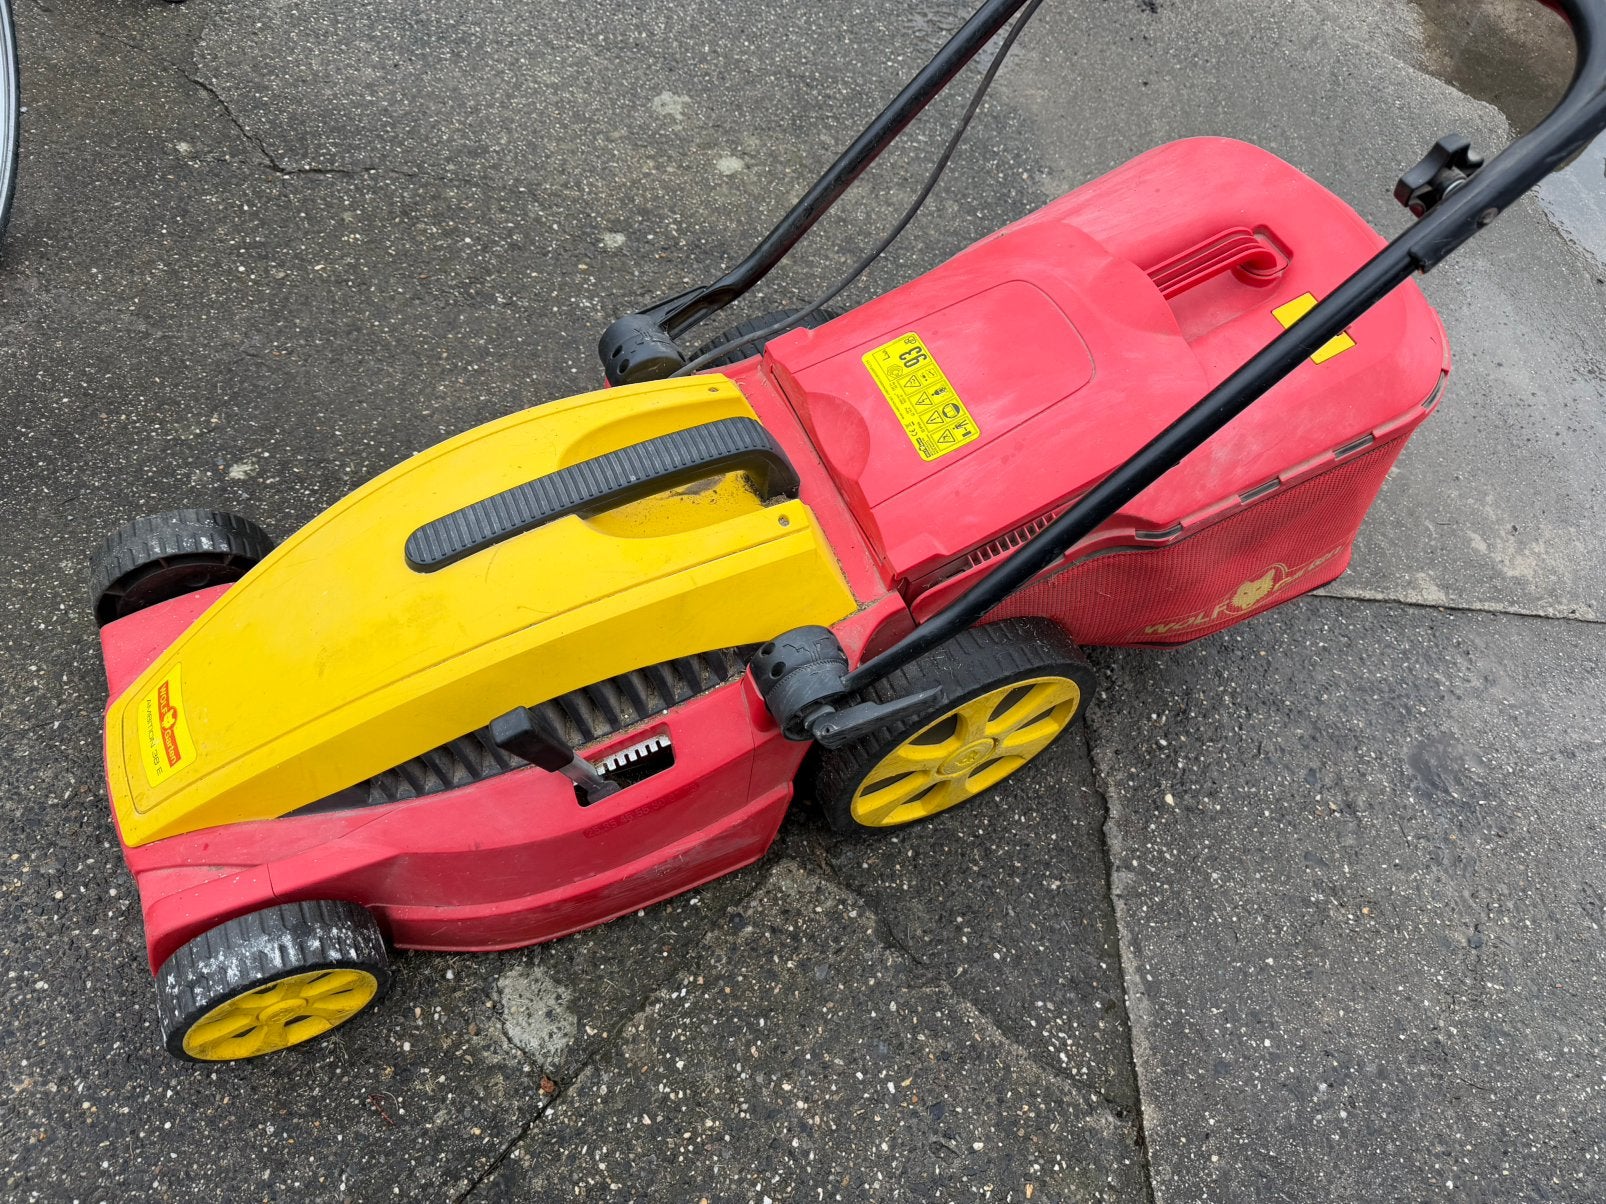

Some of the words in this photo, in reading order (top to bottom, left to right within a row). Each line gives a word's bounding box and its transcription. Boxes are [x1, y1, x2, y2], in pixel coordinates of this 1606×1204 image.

[899, 346, 928, 369] 93
[1144, 600, 1230, 634] WOLF
[159, 683, 168, 714] WOLF
[164, 729, 177, 765] Garten
[156, 767, 163, 776] E
